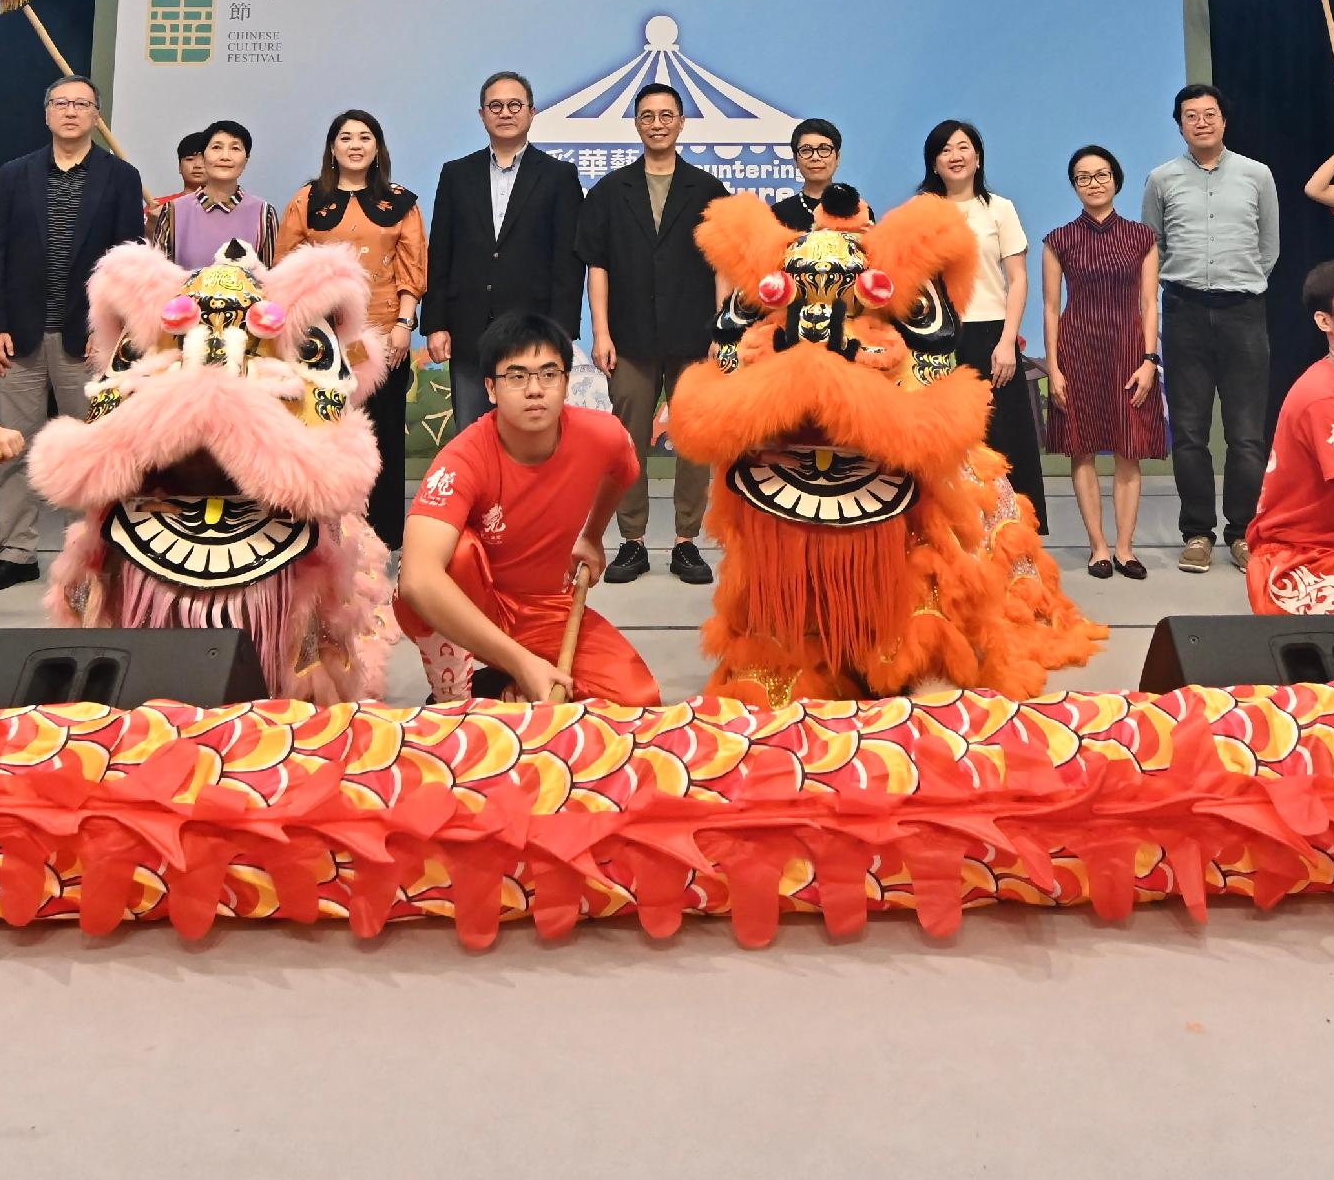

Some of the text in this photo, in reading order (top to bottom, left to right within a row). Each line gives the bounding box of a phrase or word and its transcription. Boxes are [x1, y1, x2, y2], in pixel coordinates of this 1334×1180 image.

[227, 31, 281, 40] CHINESE
[227, 42, 283, 51] CULTURE
[227, 53, 283, 62] FESTIVAL
